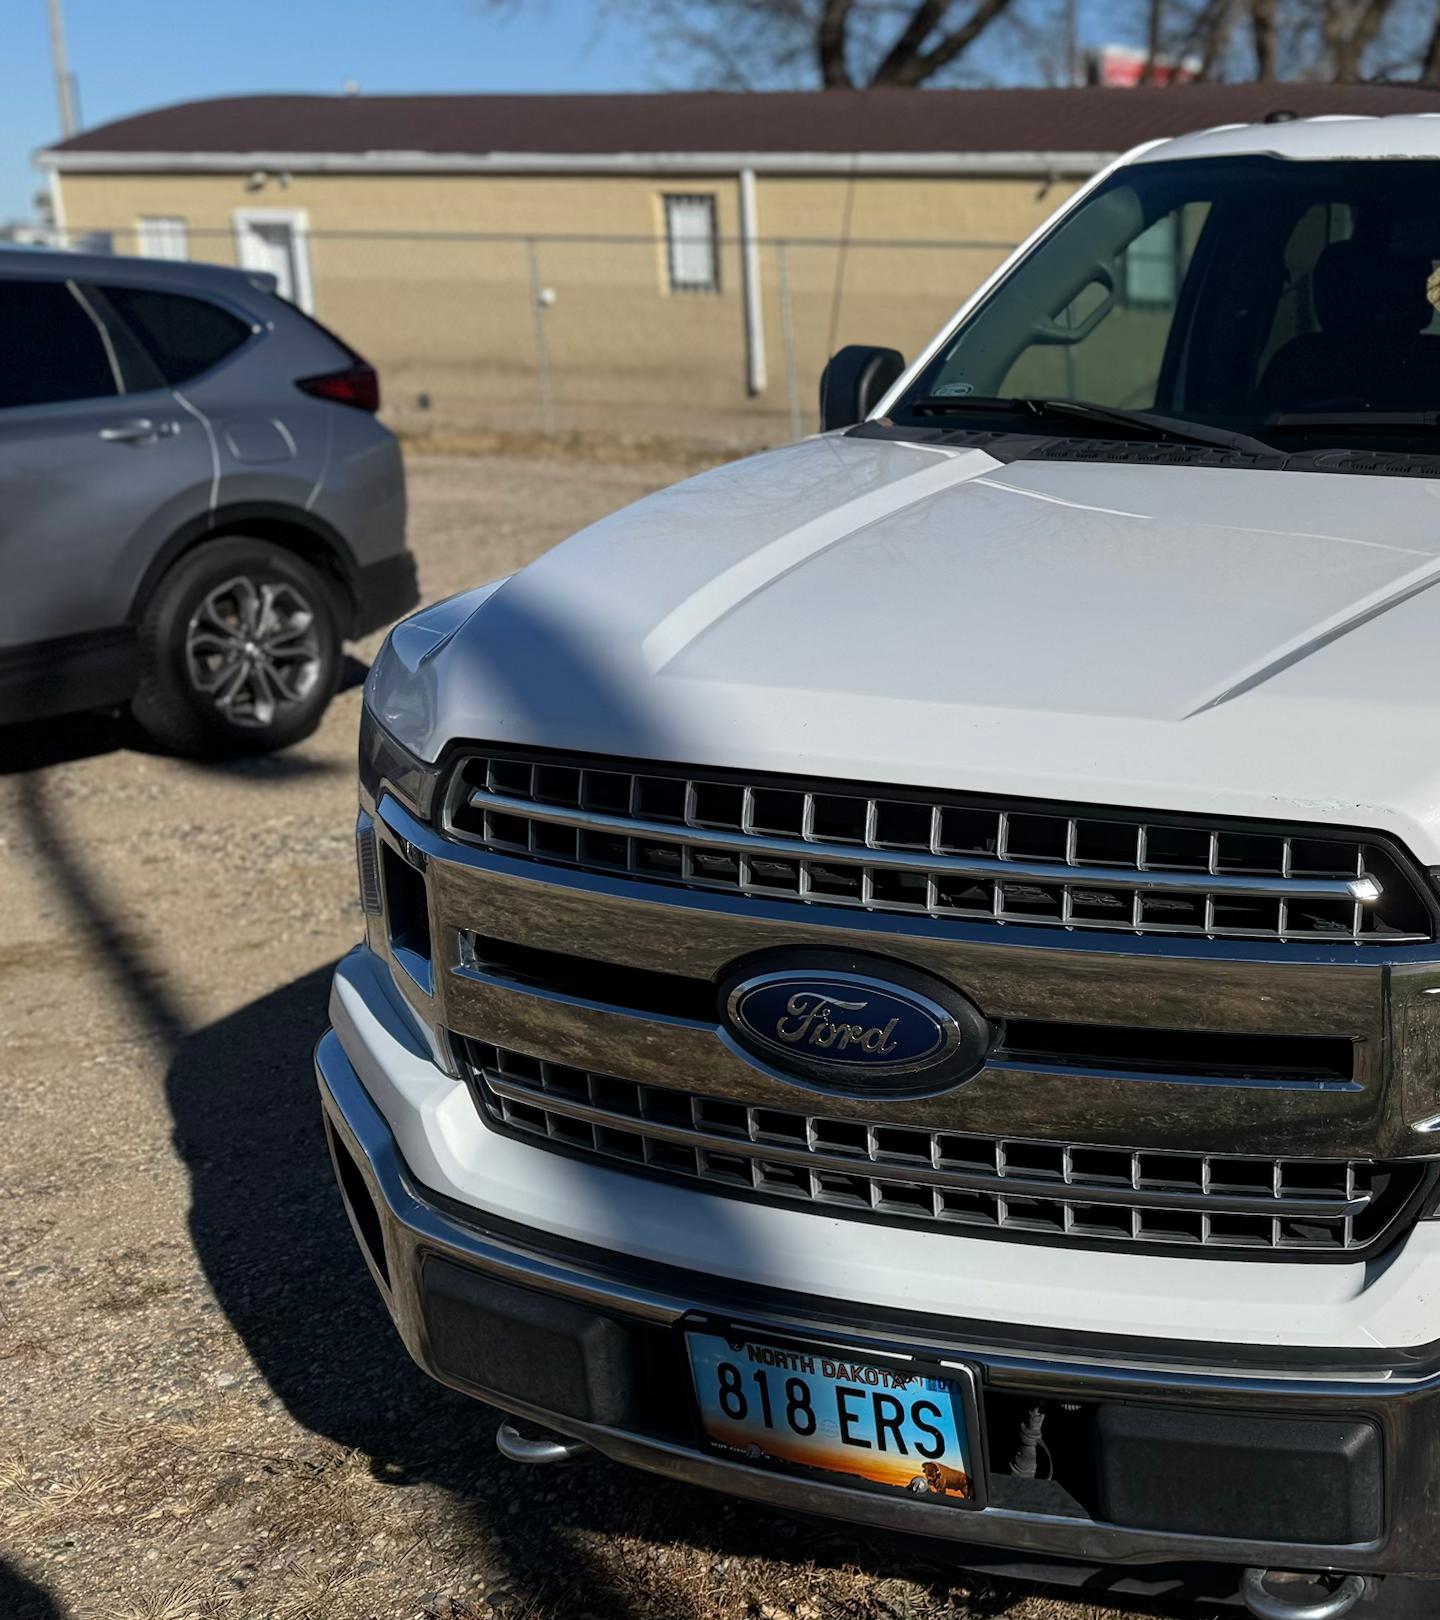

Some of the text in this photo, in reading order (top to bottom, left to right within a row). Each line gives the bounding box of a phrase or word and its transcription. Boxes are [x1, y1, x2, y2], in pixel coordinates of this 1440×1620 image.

[776, 992, 899, 1055] Ford
[748, 1345, 815, 1375] NORTH
[822, 1360, 907, 1391] DAKOTA
[717, 1362, 946, 1460] 818 ERS
